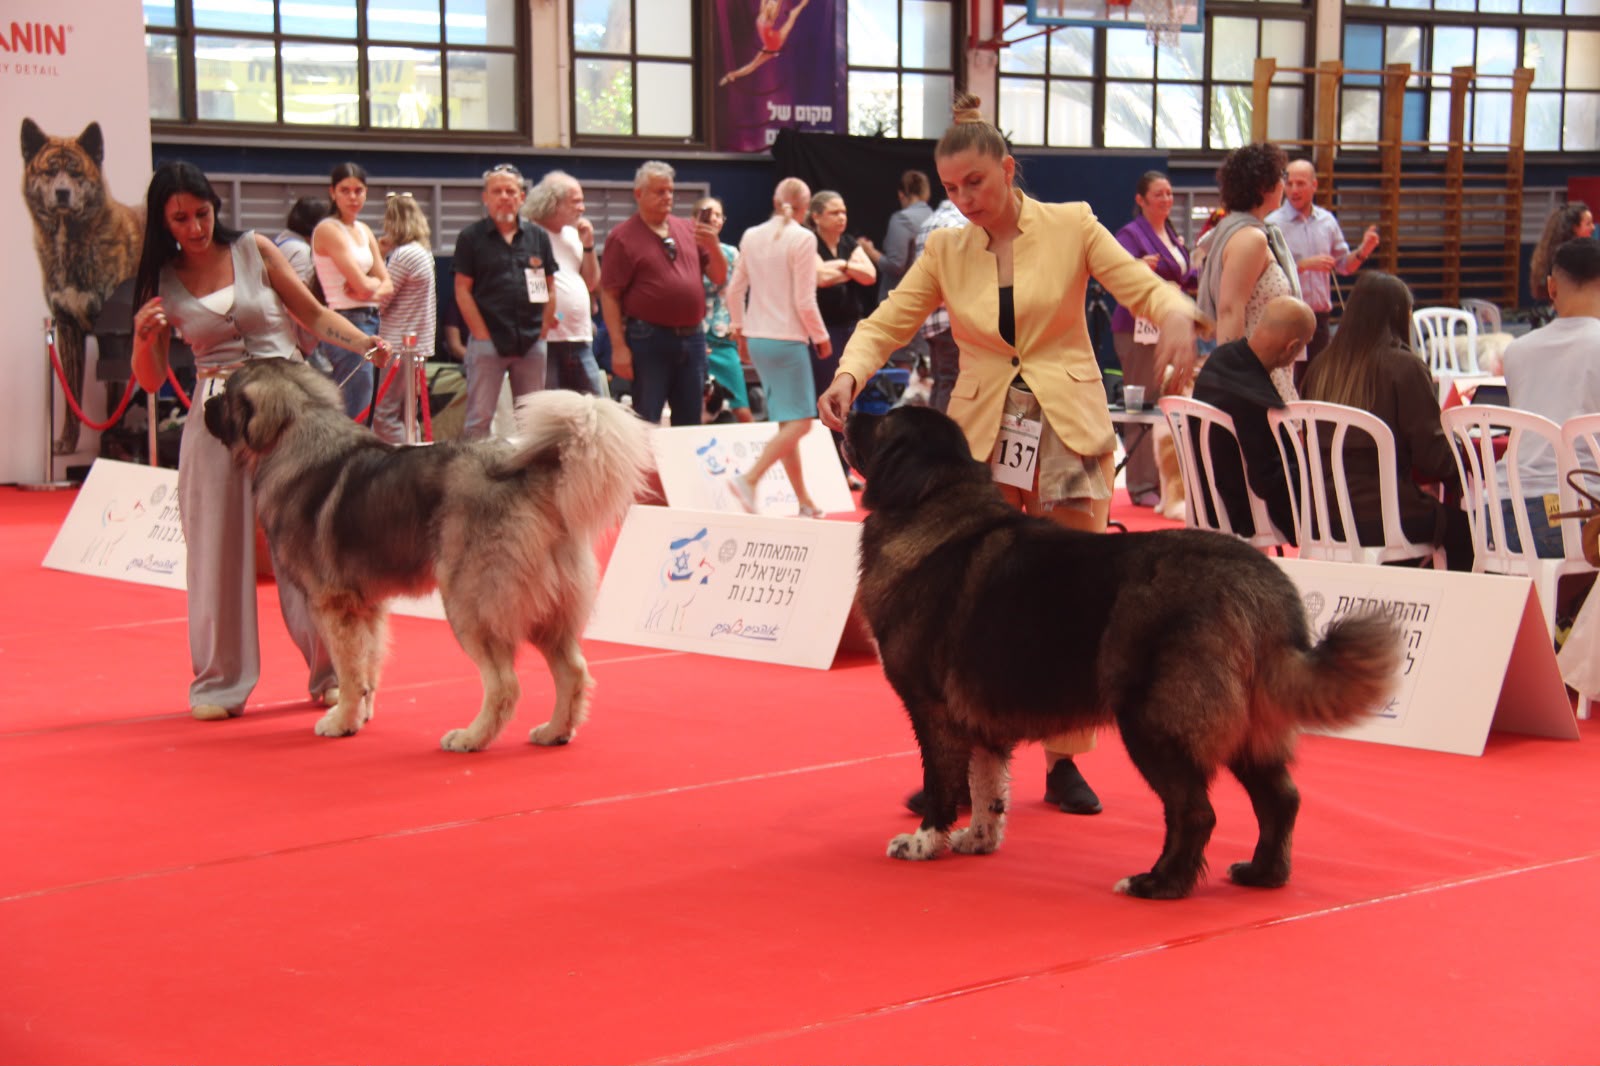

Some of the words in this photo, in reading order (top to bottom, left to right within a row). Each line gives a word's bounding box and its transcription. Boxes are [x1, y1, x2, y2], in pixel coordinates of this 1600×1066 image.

[15, 64, 60, 77] DETAIL
[766, 100, 792, 121] של
[794, 104, 833, 127] מקום
[998, 438, 1036, 473] 137
[742, 541, 808, 562] ההתאחדות
[735, 560, 801, 584] הישראלית
[727, 584, 794, 606] לכלבנות
